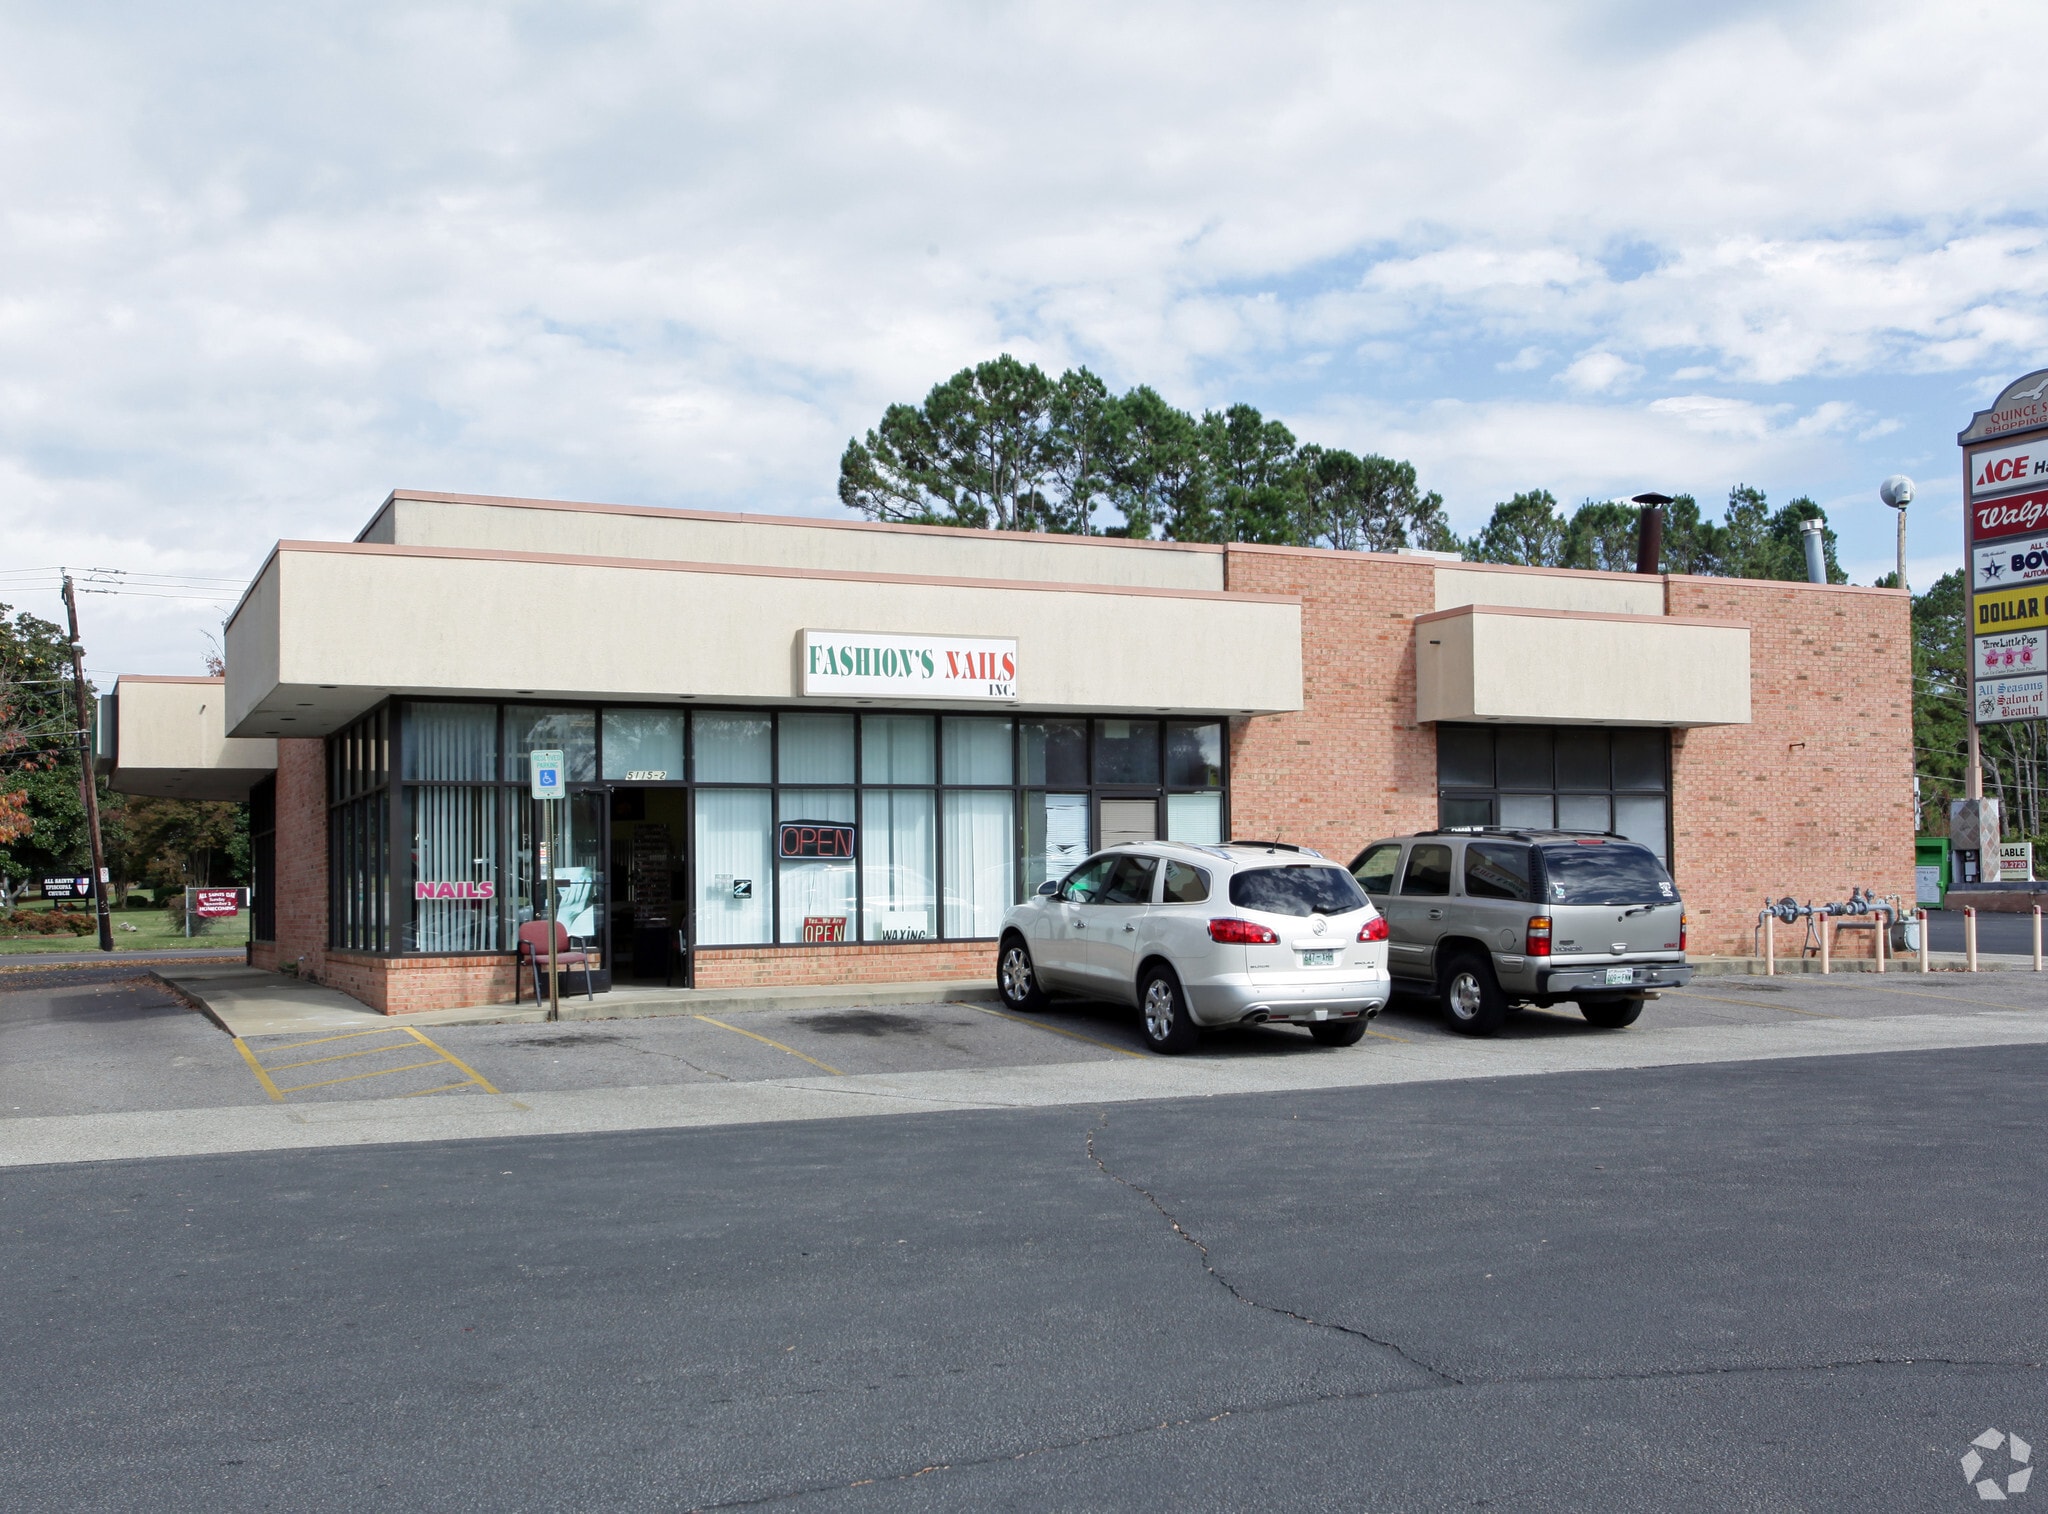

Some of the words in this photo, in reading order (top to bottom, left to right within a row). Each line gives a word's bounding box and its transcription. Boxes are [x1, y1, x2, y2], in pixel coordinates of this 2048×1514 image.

[1991, 404, 2037, 424] QUINCE
[1985, 414, 2048, 435] SHOPPING
[1976, 455, 2030, 486] ACE
[1979, 597, 2039, 625] DOLLAR
[1982, 639, 2000, 649] Three
[2021, 634, 2038, 647] Pigs
[808, 644, 935, 679] FASHION'S
[945, 651, 1015, 682] NAILS
[989, 683, 1015, 697] INC.
[1978, 684, 1993, 696] All
[1997, 682, 2043, 694] Seasons
[1997, 694, 2029, 706] Salon
[2032, 690, 2044, 702] of
[2001, 704, 2039, 717] Beauty
[627, 771, 666, 780] 5115-2
[782, 827, 852, 857] OPEN
[416, 881, 494, 899] NAILS
[804, 925, 844, 942] OPEN
